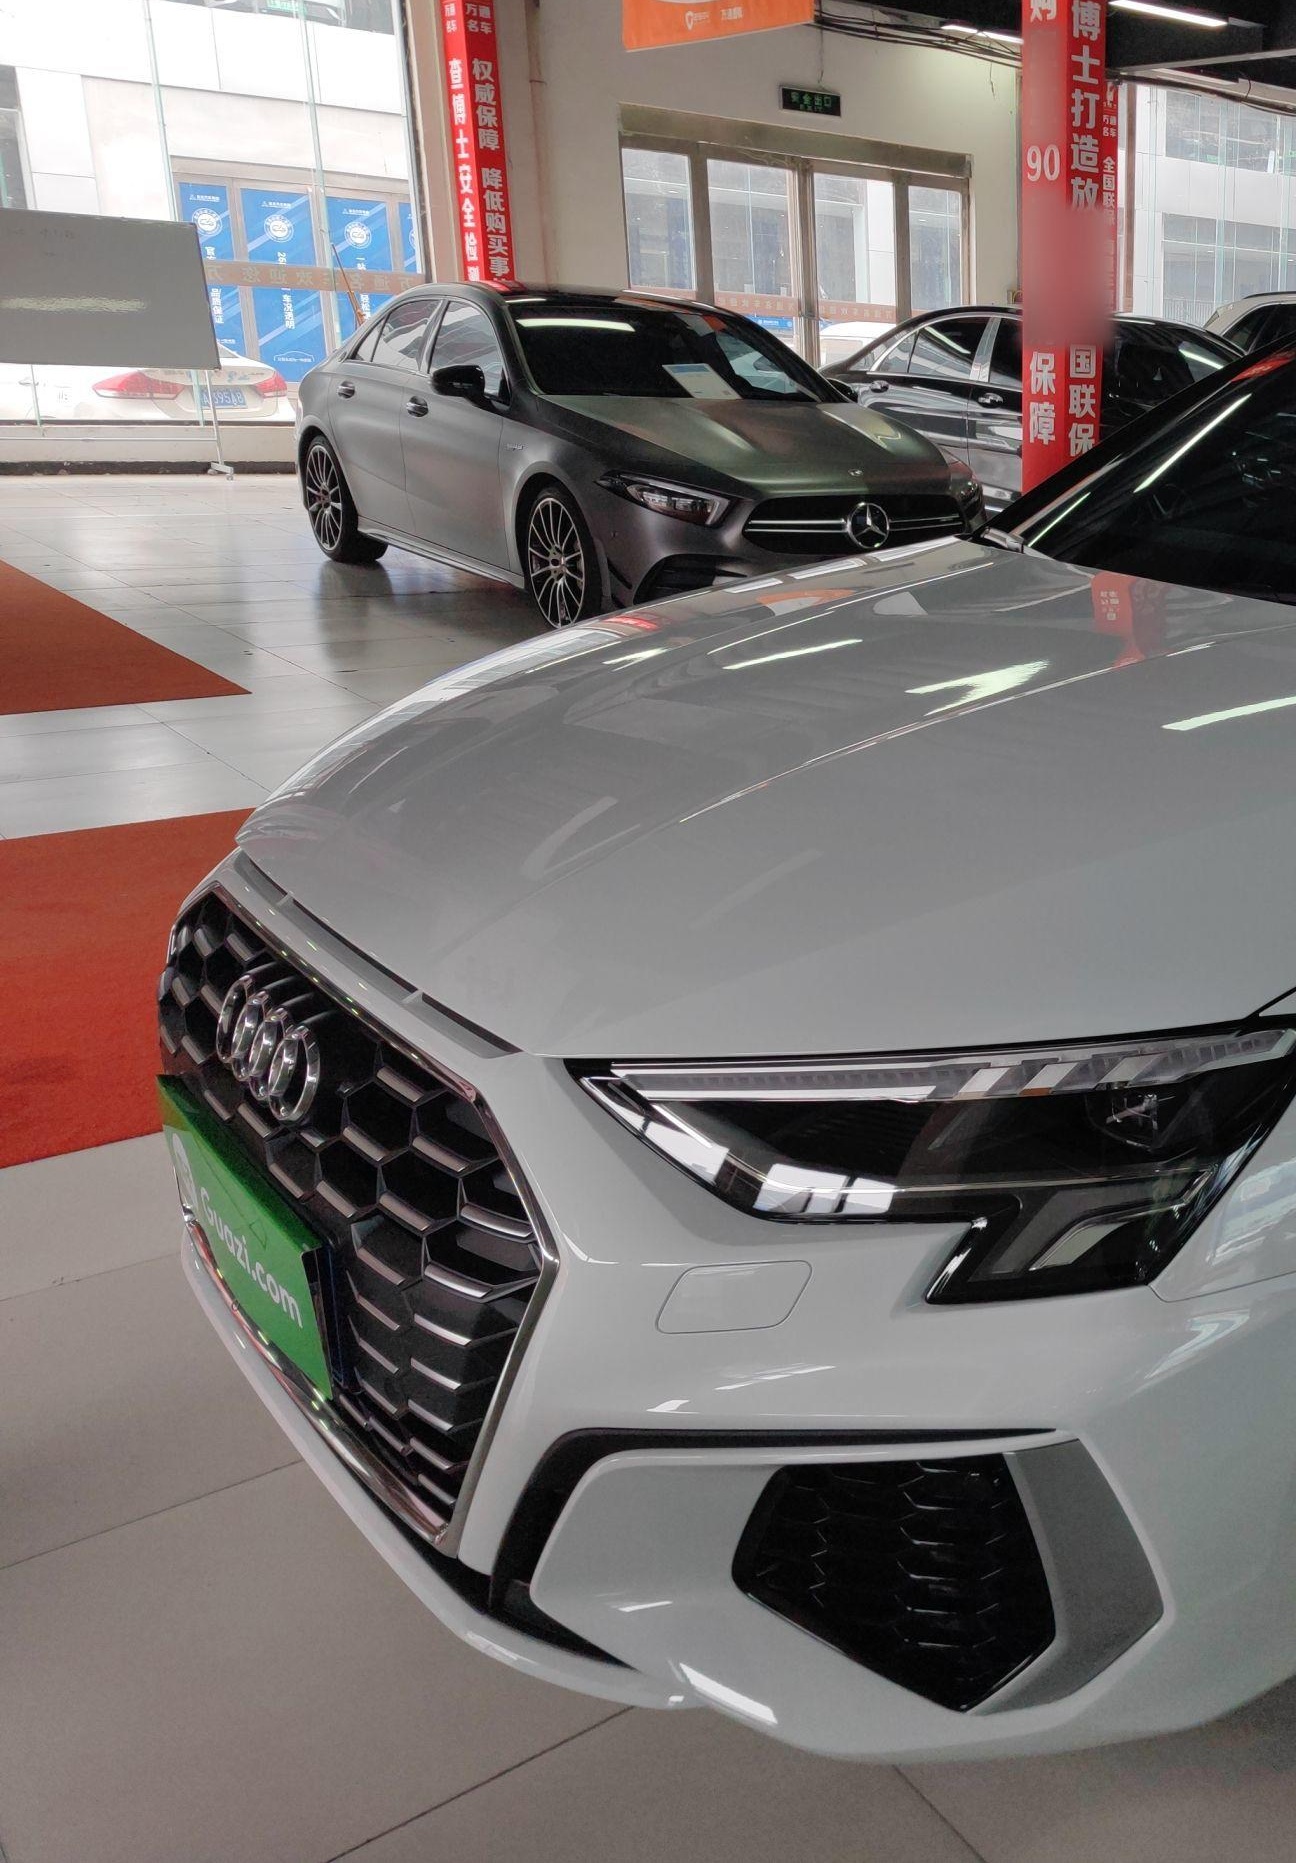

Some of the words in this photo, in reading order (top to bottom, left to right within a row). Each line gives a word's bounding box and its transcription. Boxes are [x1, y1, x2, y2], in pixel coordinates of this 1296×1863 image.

[465, 3, 491, 18] 万通
[468, 19, 492, 35] 名车
[472, 58, 499, 150] 权威保障
[1026, 145, 1061, 182] 90
[481, 167, 510, 281] 降低购买事
[1029, 351, 1056, 446] 保障
[1068, 344, 1097, 457] 国联保
[200, 1186, 304, 1329] Guazi.com
